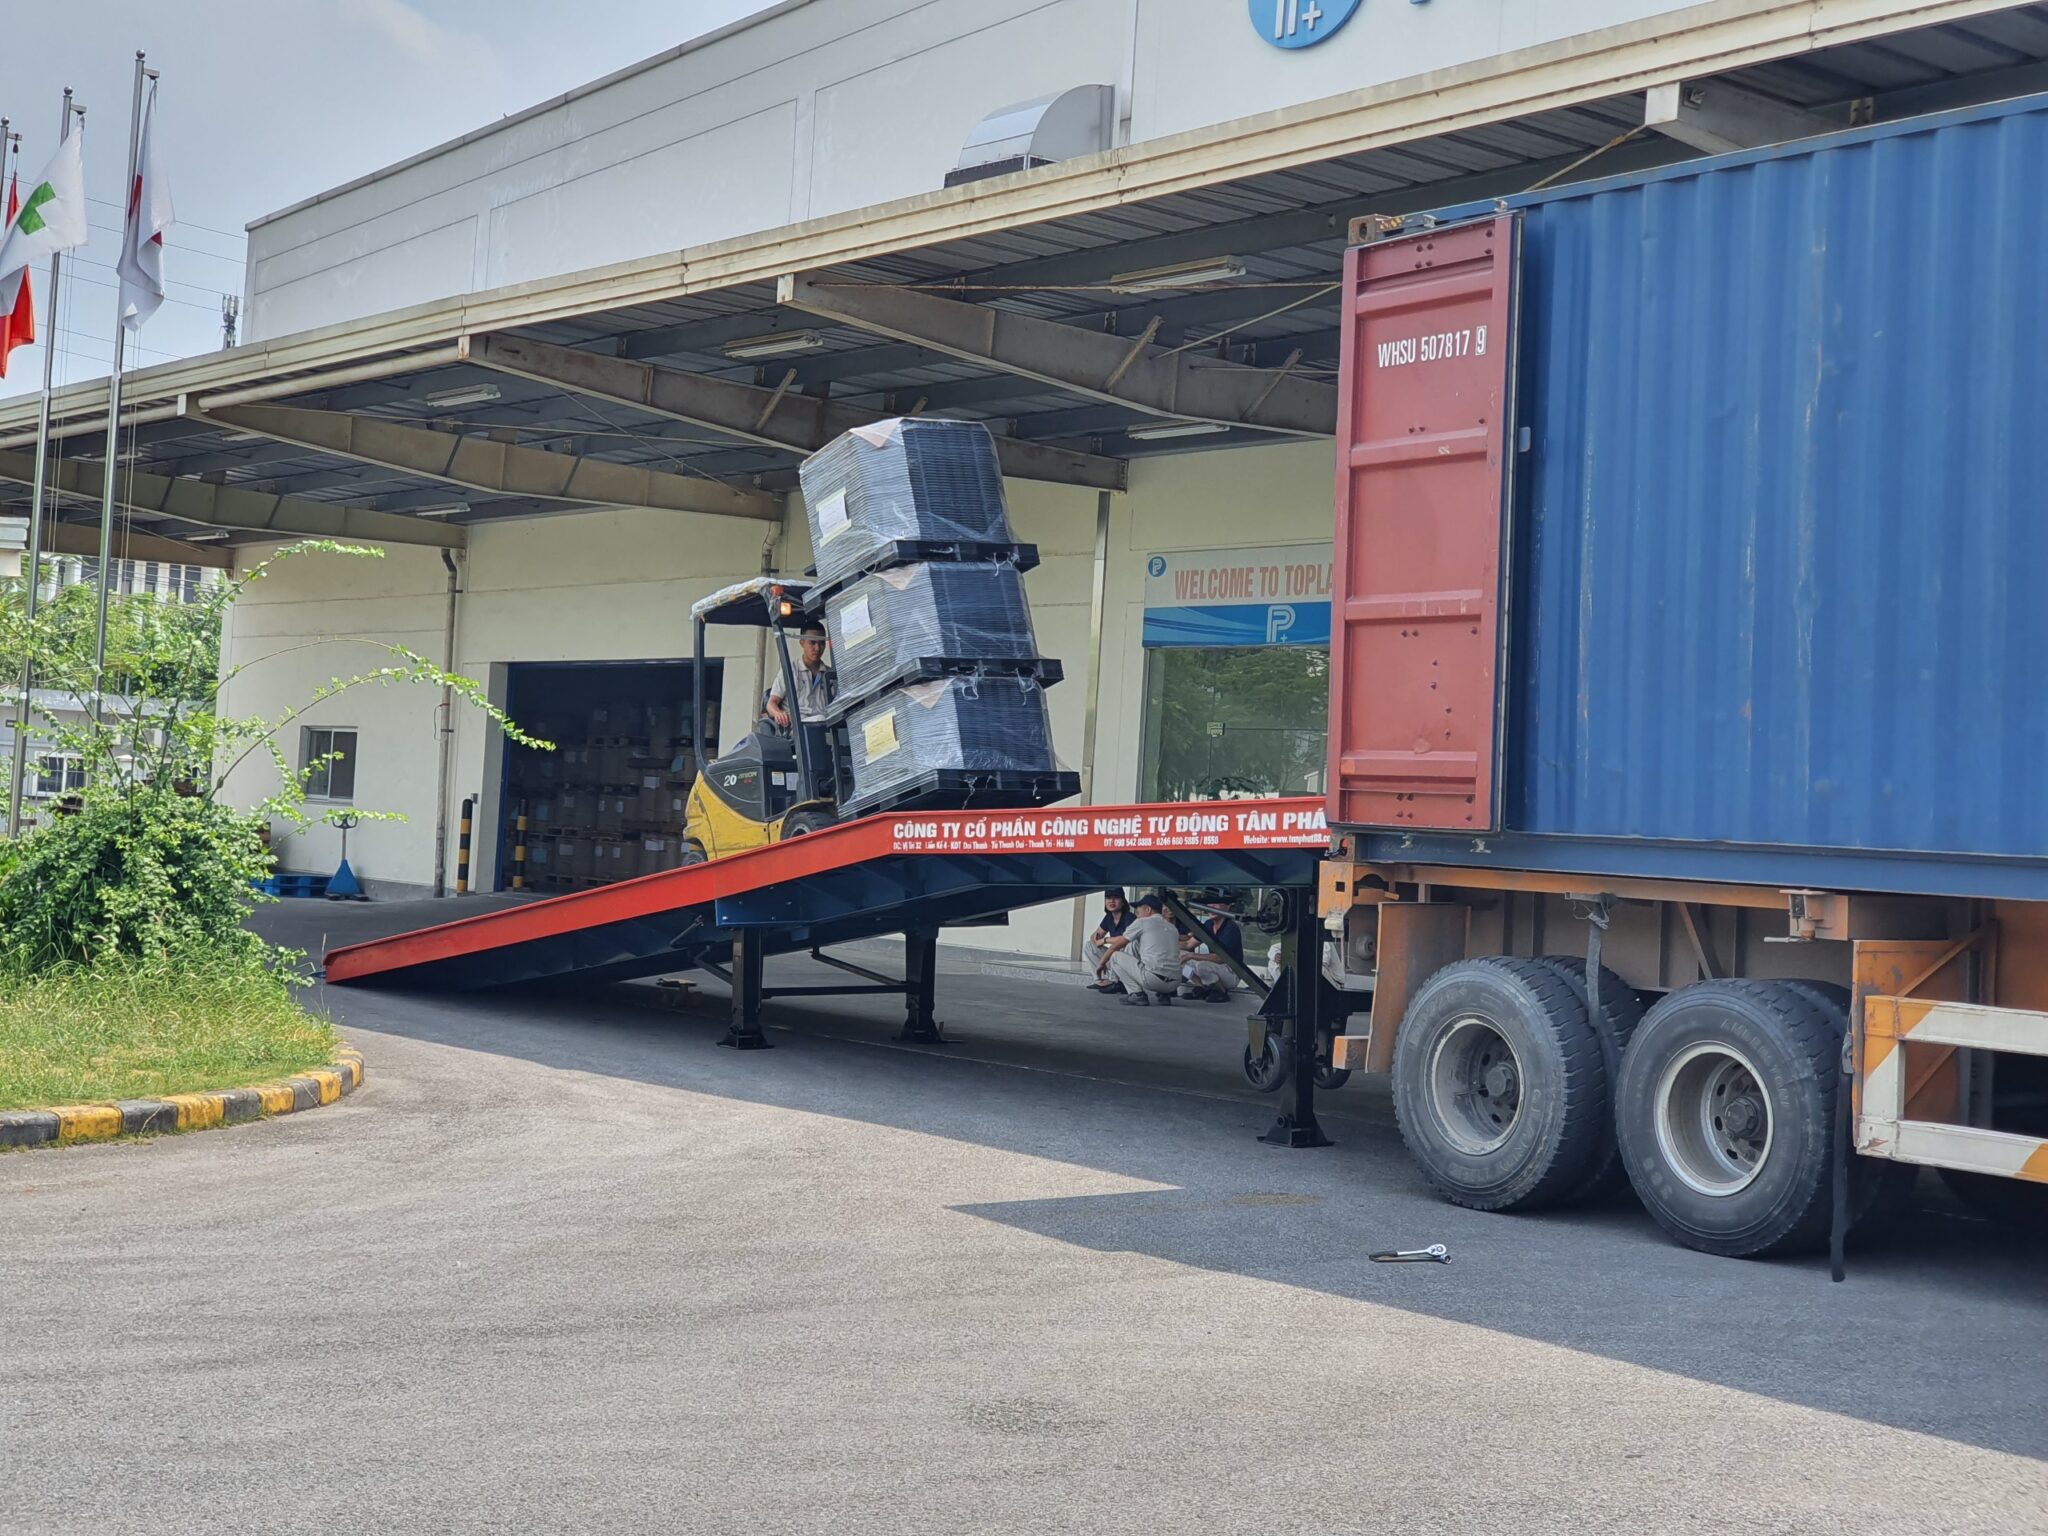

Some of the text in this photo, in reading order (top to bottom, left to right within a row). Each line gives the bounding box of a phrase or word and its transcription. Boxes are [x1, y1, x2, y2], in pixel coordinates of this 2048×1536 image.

[1378, 327, 1486, 368] WHSU 507817 9
[1174, 567, 1254, 600] WELCOME
[1259, 566, 1279, 597] TO
[724, 774, 737, 787] 20
[893, 807, 1327, 838] CÔNG TY CỔ PHẦN CÔNG NGHỆ TỰ ĐỘNG TÂN PHÁ
